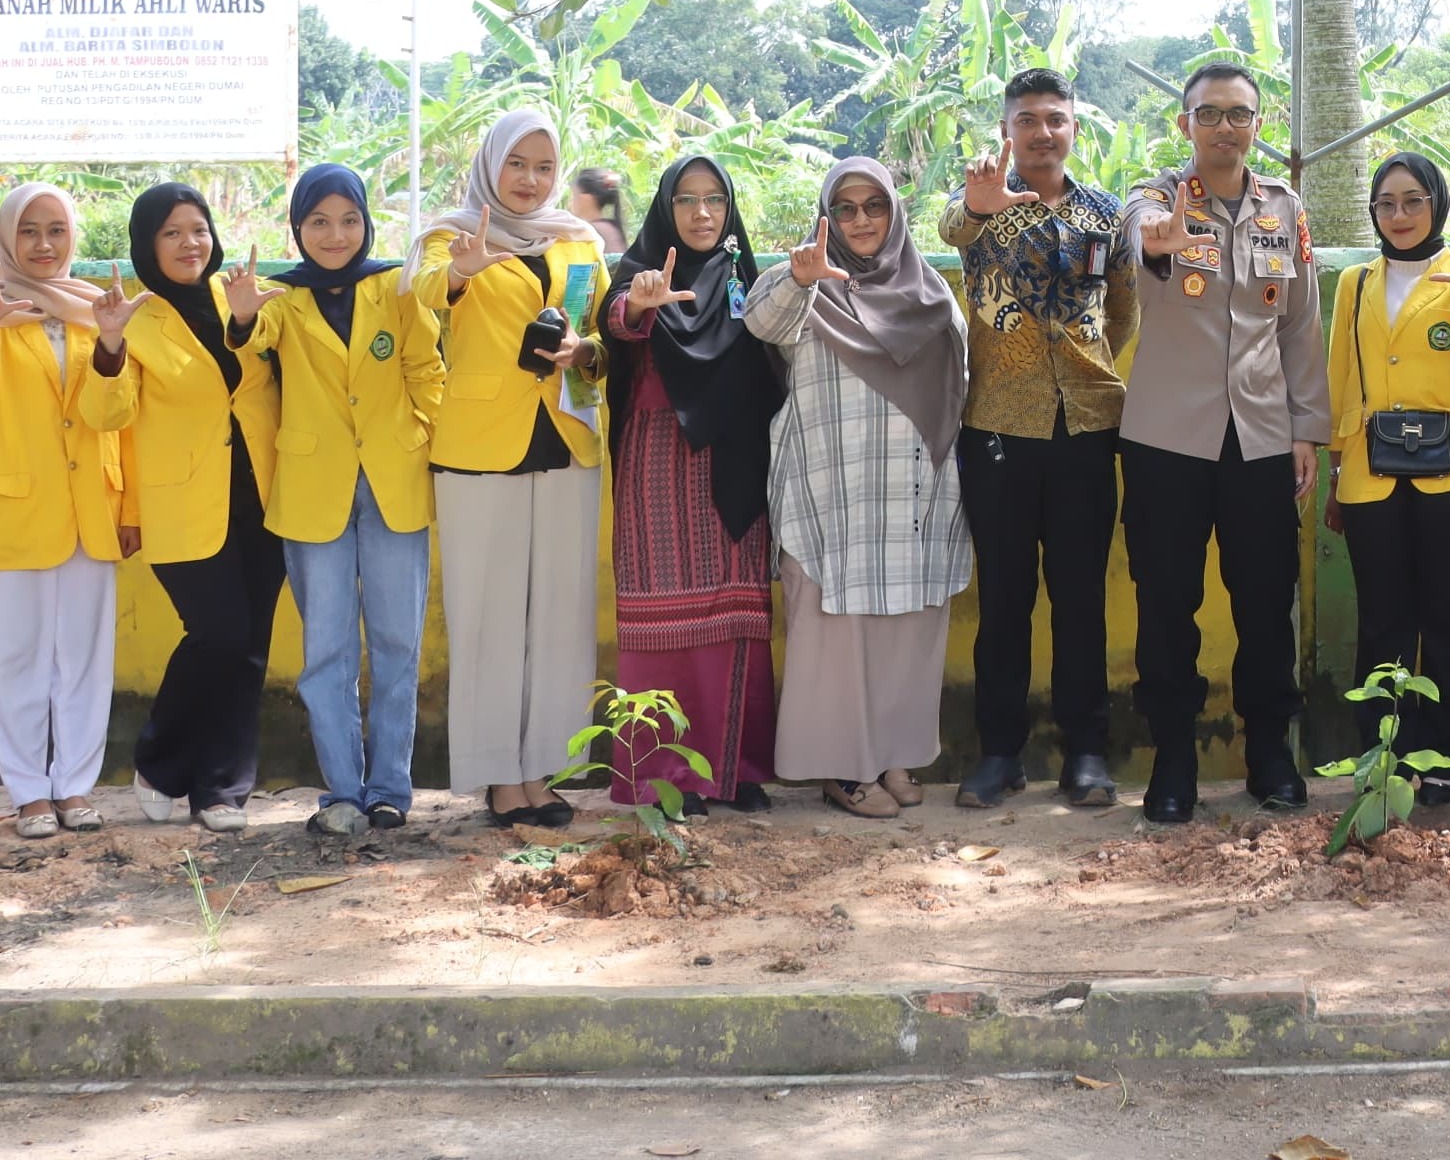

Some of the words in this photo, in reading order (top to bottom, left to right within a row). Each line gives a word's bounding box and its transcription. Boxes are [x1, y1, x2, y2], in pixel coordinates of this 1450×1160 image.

[19, 41, 60, 53] ALM.
[64, 40, 126, 52] BARITA
[132, 39, 224, 52] SIMBOLON
[41, 57, 64, 67] JUAL
[56, 70, 78, 79] DAN
[82, 70, 117, 79] TELAH
[133, 70, 187, 79] EKSEKUSI
[92, 83, 161, 92] PENGADILAN
[164, 82, 205, 91] NEGERI
[208, 81, 244, 90] DUMAI
[1251, 235, 1289, 249] POLRI
